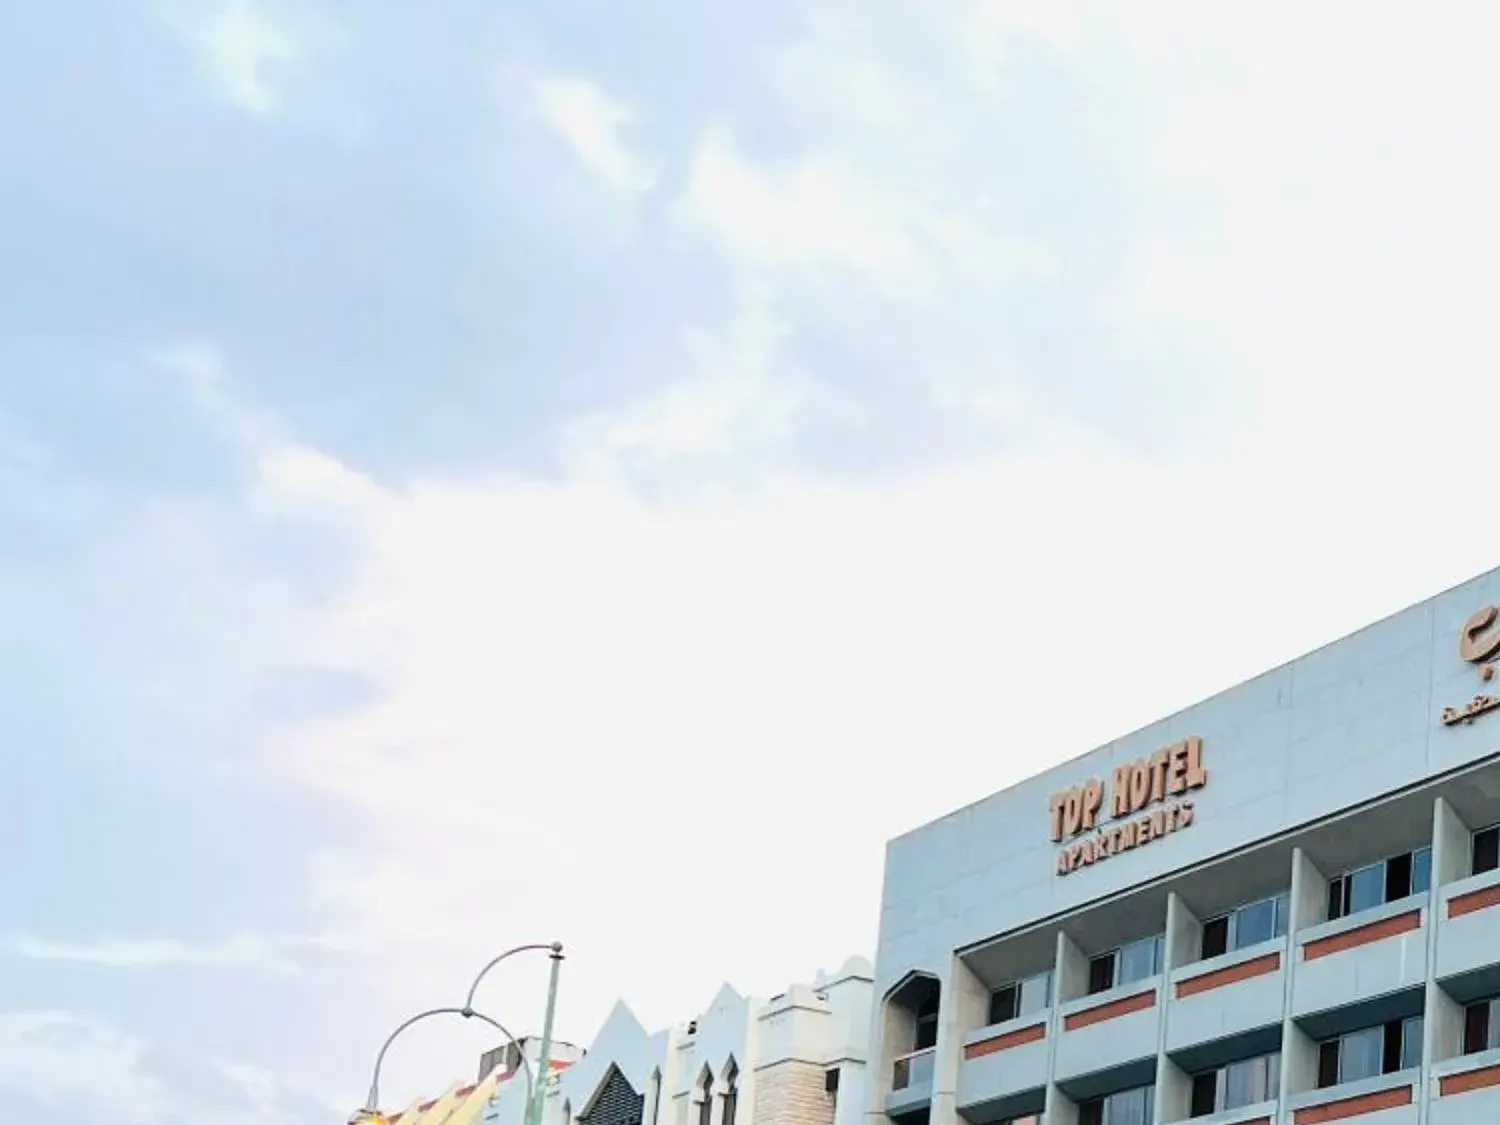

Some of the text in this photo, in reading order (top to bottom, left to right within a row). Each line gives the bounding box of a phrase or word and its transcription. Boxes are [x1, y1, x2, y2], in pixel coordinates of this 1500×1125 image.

[1049, 735, 1208, 843] TOP HOTEL
[1056, 800, 1195, 877] APARTMENTS
